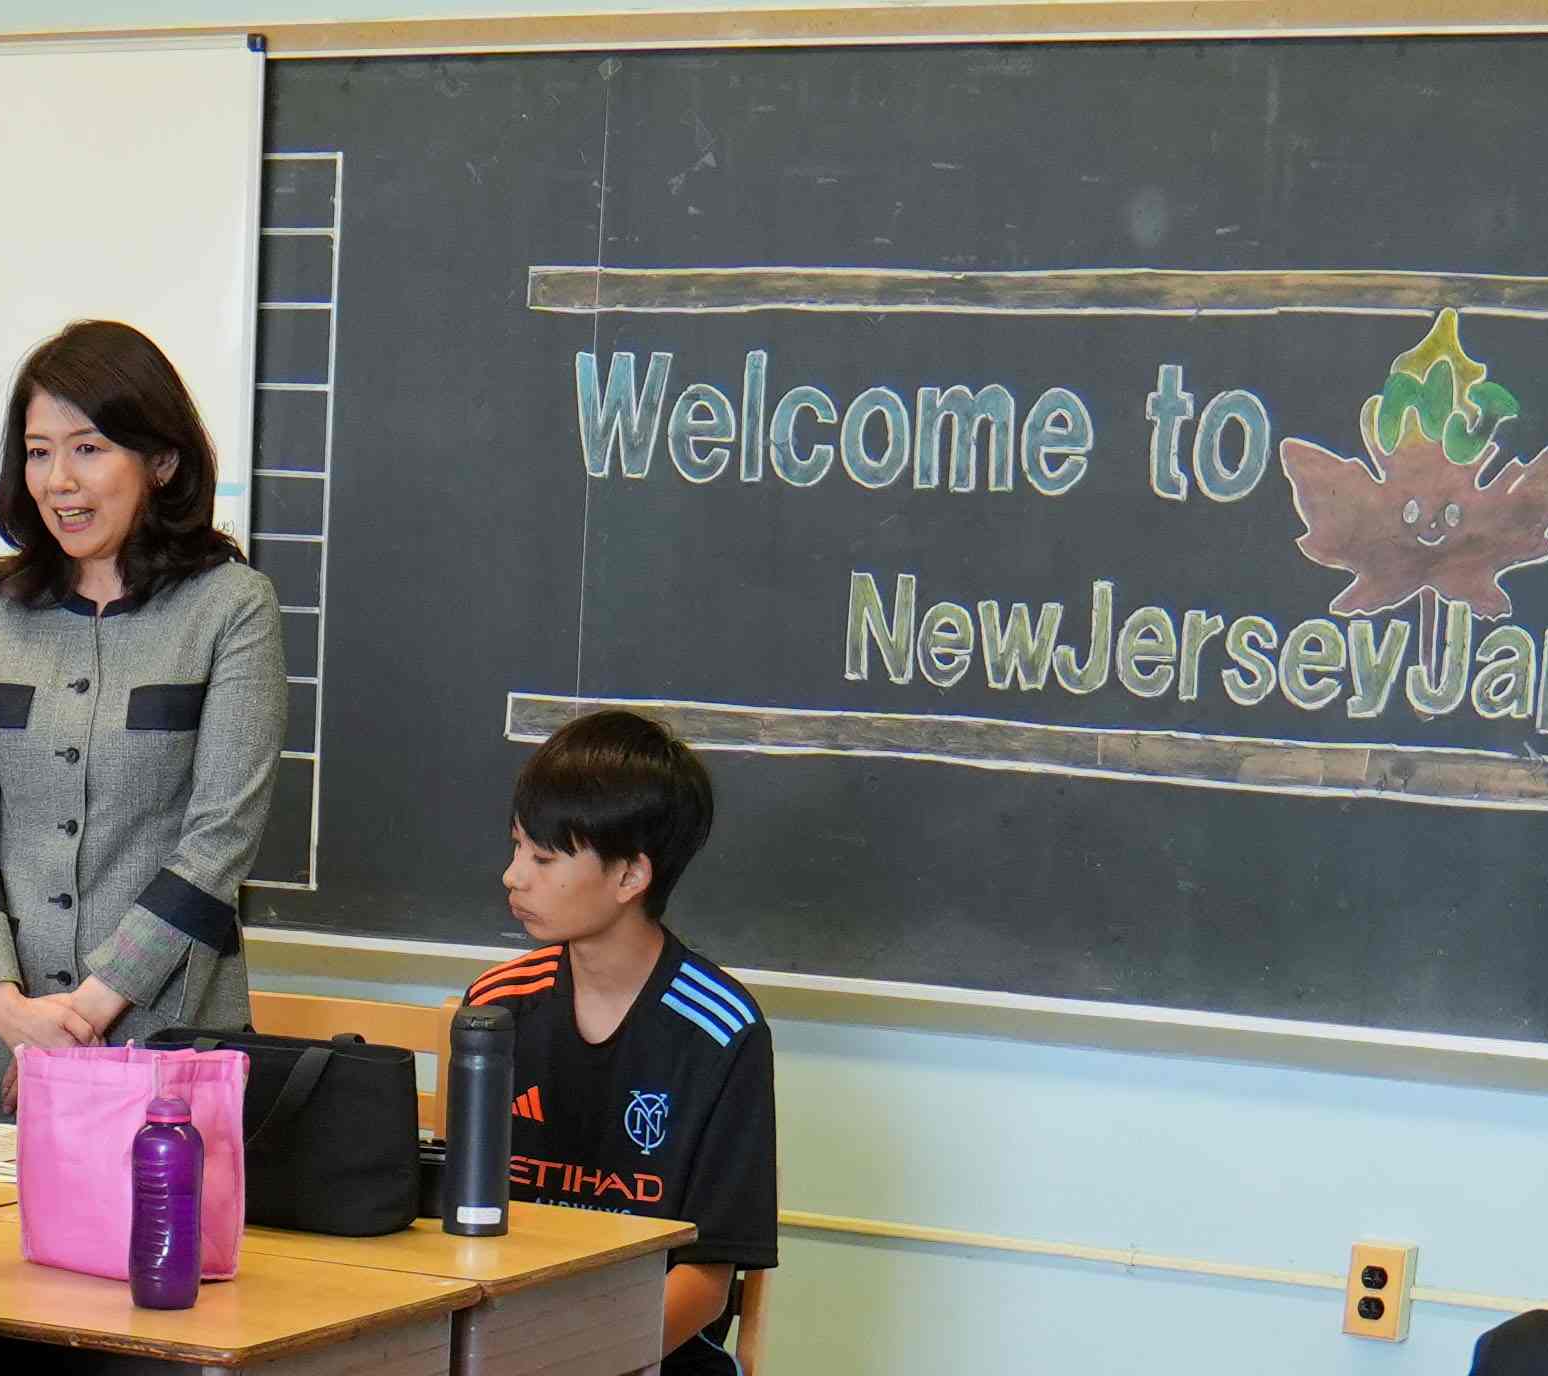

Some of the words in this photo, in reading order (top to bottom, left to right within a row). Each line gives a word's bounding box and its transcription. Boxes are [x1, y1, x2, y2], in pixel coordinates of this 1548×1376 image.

[575, 350, 1093, 497] Welcome
[1144, 364, 1271, 502] to
[509, 1154, 665, 1203] ETIHAD
